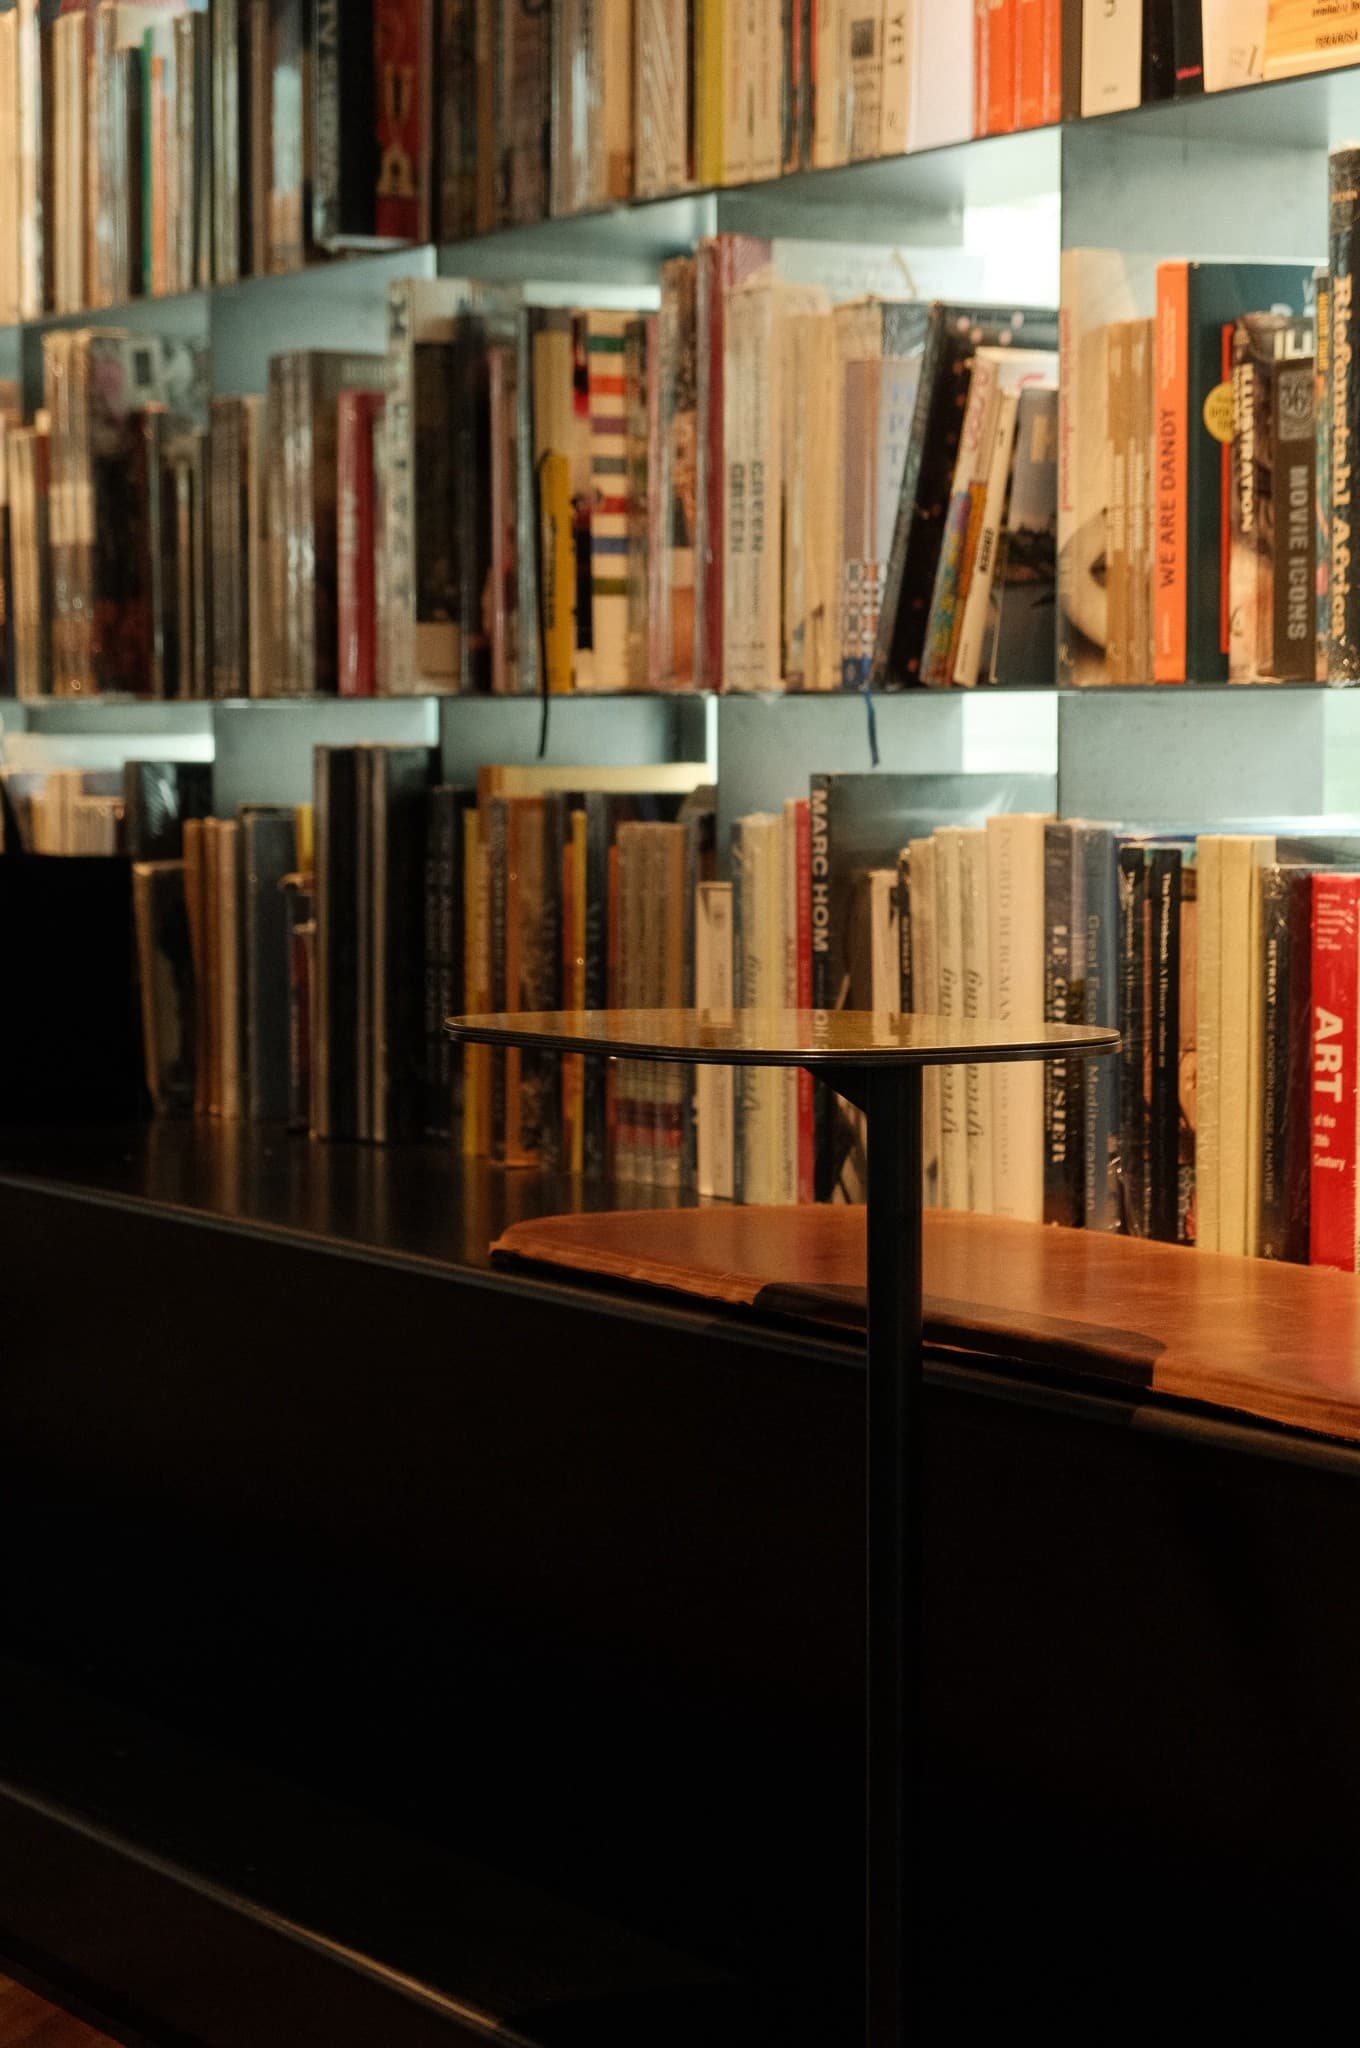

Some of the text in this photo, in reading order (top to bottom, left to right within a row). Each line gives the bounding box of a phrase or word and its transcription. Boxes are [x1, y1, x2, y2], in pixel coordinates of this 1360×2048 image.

[1240, 363, 1255, 532] ILLUSTRATION
[1331, 275, 1352, 639] Riefenstahl Africa
[1160, 408, 1176, 588] WE ARE DANDY
[1288, 465, 1308, 640] MOVIE ICONS
[812, 788, 830, 875] MARC
[999, 827, 1013, 909] INGRID
[1161, 872, 1172, 895] The
[813, 882, 830, 953] HOM
[1086, 913, 1100, 968] Great
[1266, 939, 1277, 1005] RETREAT
[1266, 1008, 1276, 1031] THE
[1266, 1034, 1276, 1089] MODERN
[1313, 1007, 1344, 1103] ART
[1085, 1064, 1099, 1211] Mediterranean
[1265, 1091, 1275, 1134] HOUSE
[1322, 1113, 1337, 1128] the
[1264, 1152, 1274, 1203] NATURE
[1313, 1153, 1347, 1172] Century
